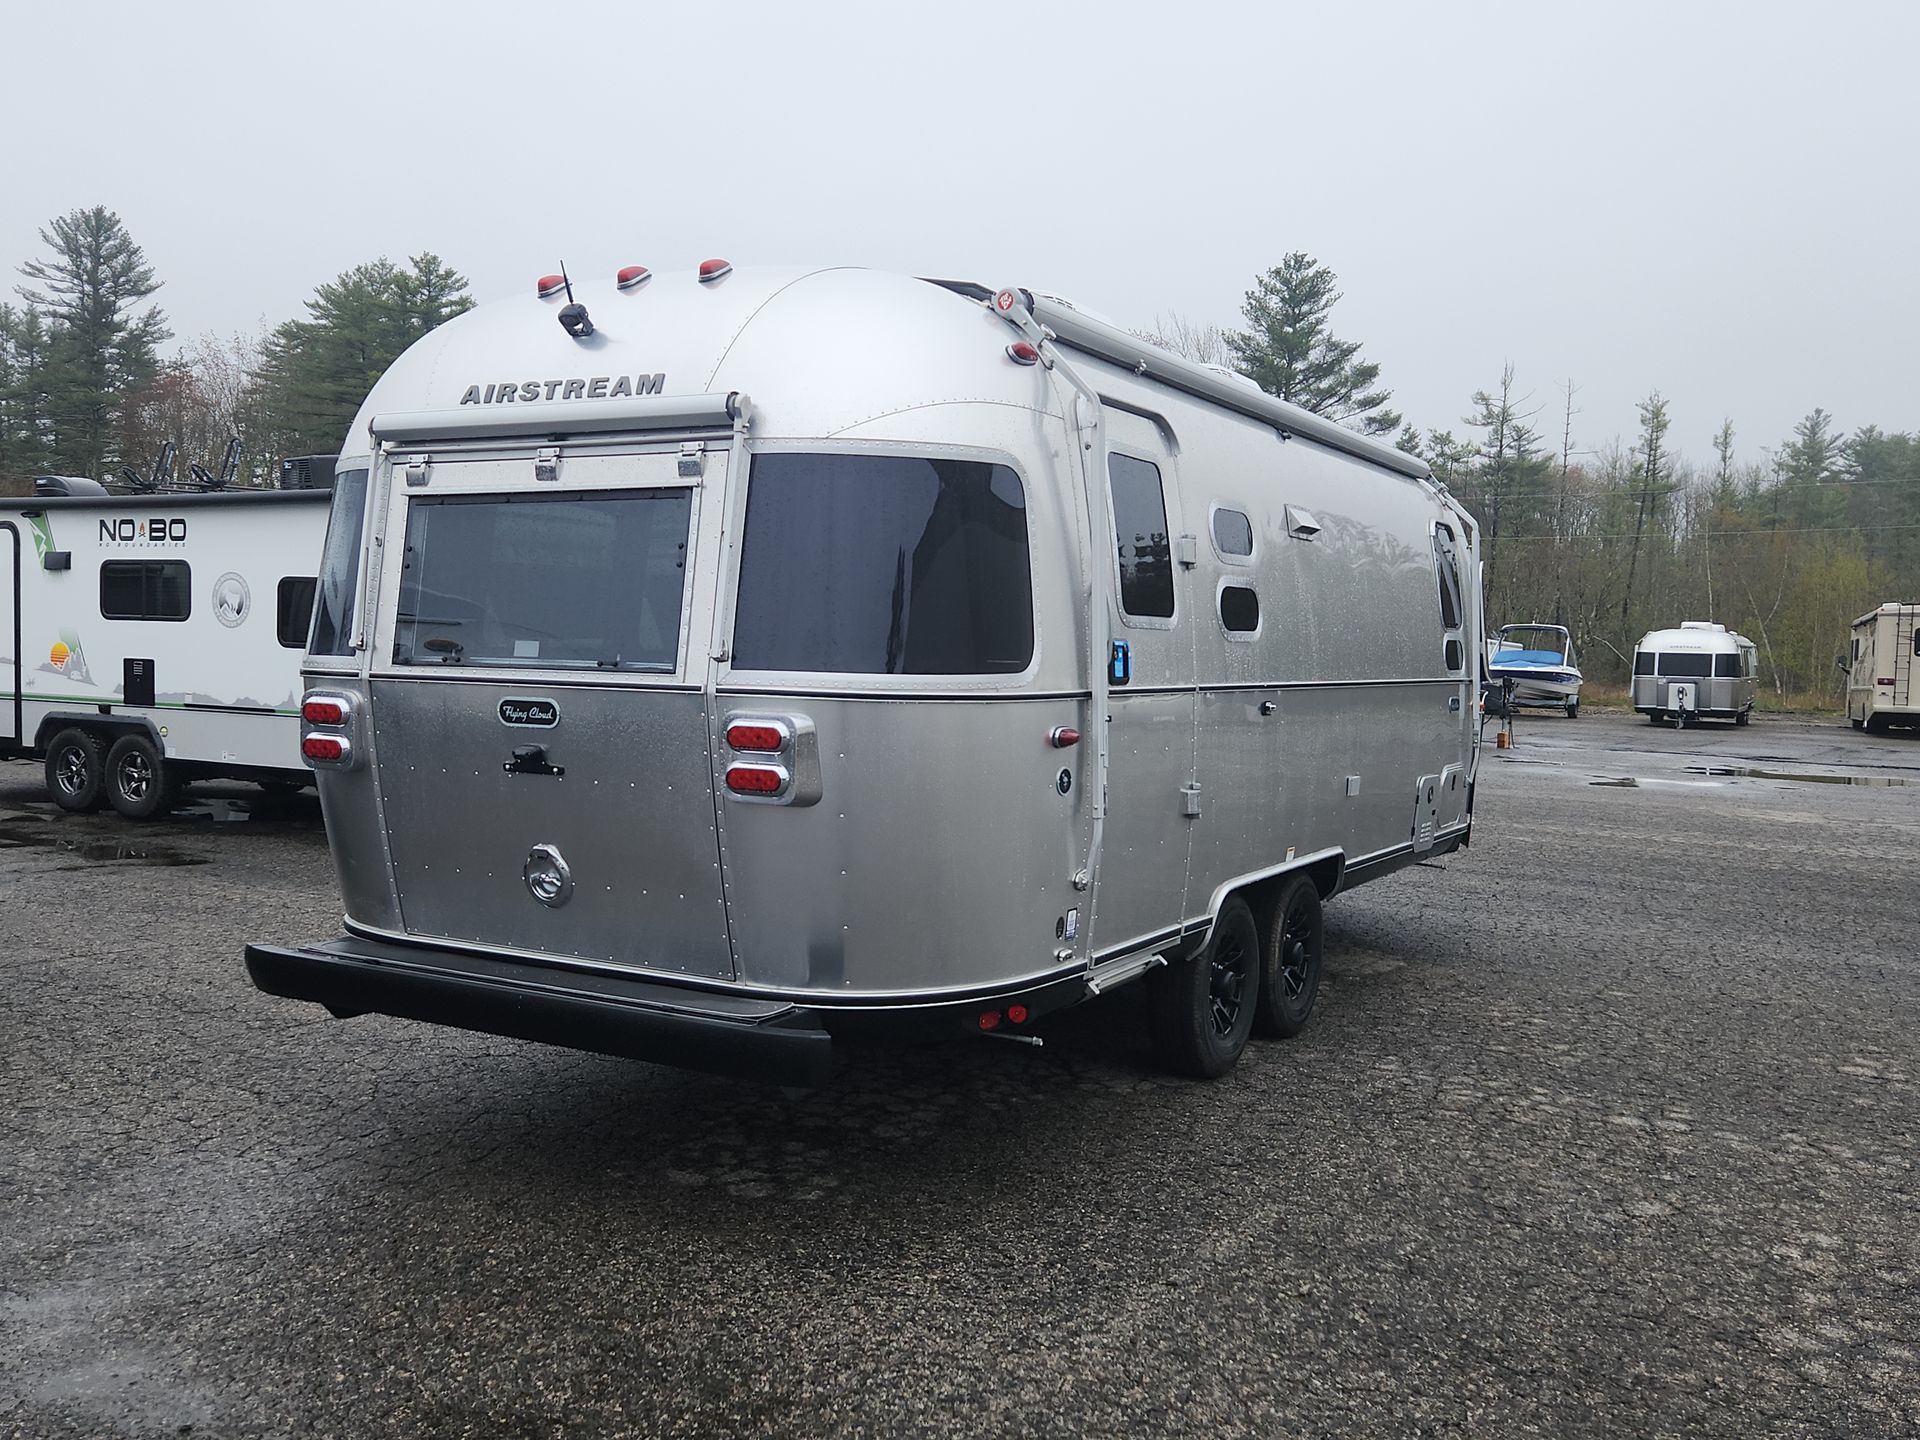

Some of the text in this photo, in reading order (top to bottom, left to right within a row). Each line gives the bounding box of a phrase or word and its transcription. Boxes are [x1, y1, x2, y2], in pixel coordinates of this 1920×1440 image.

[460, 373, 666, 405] AIRSTREAM
[503, 705, 554, 722] Flying Cloud
